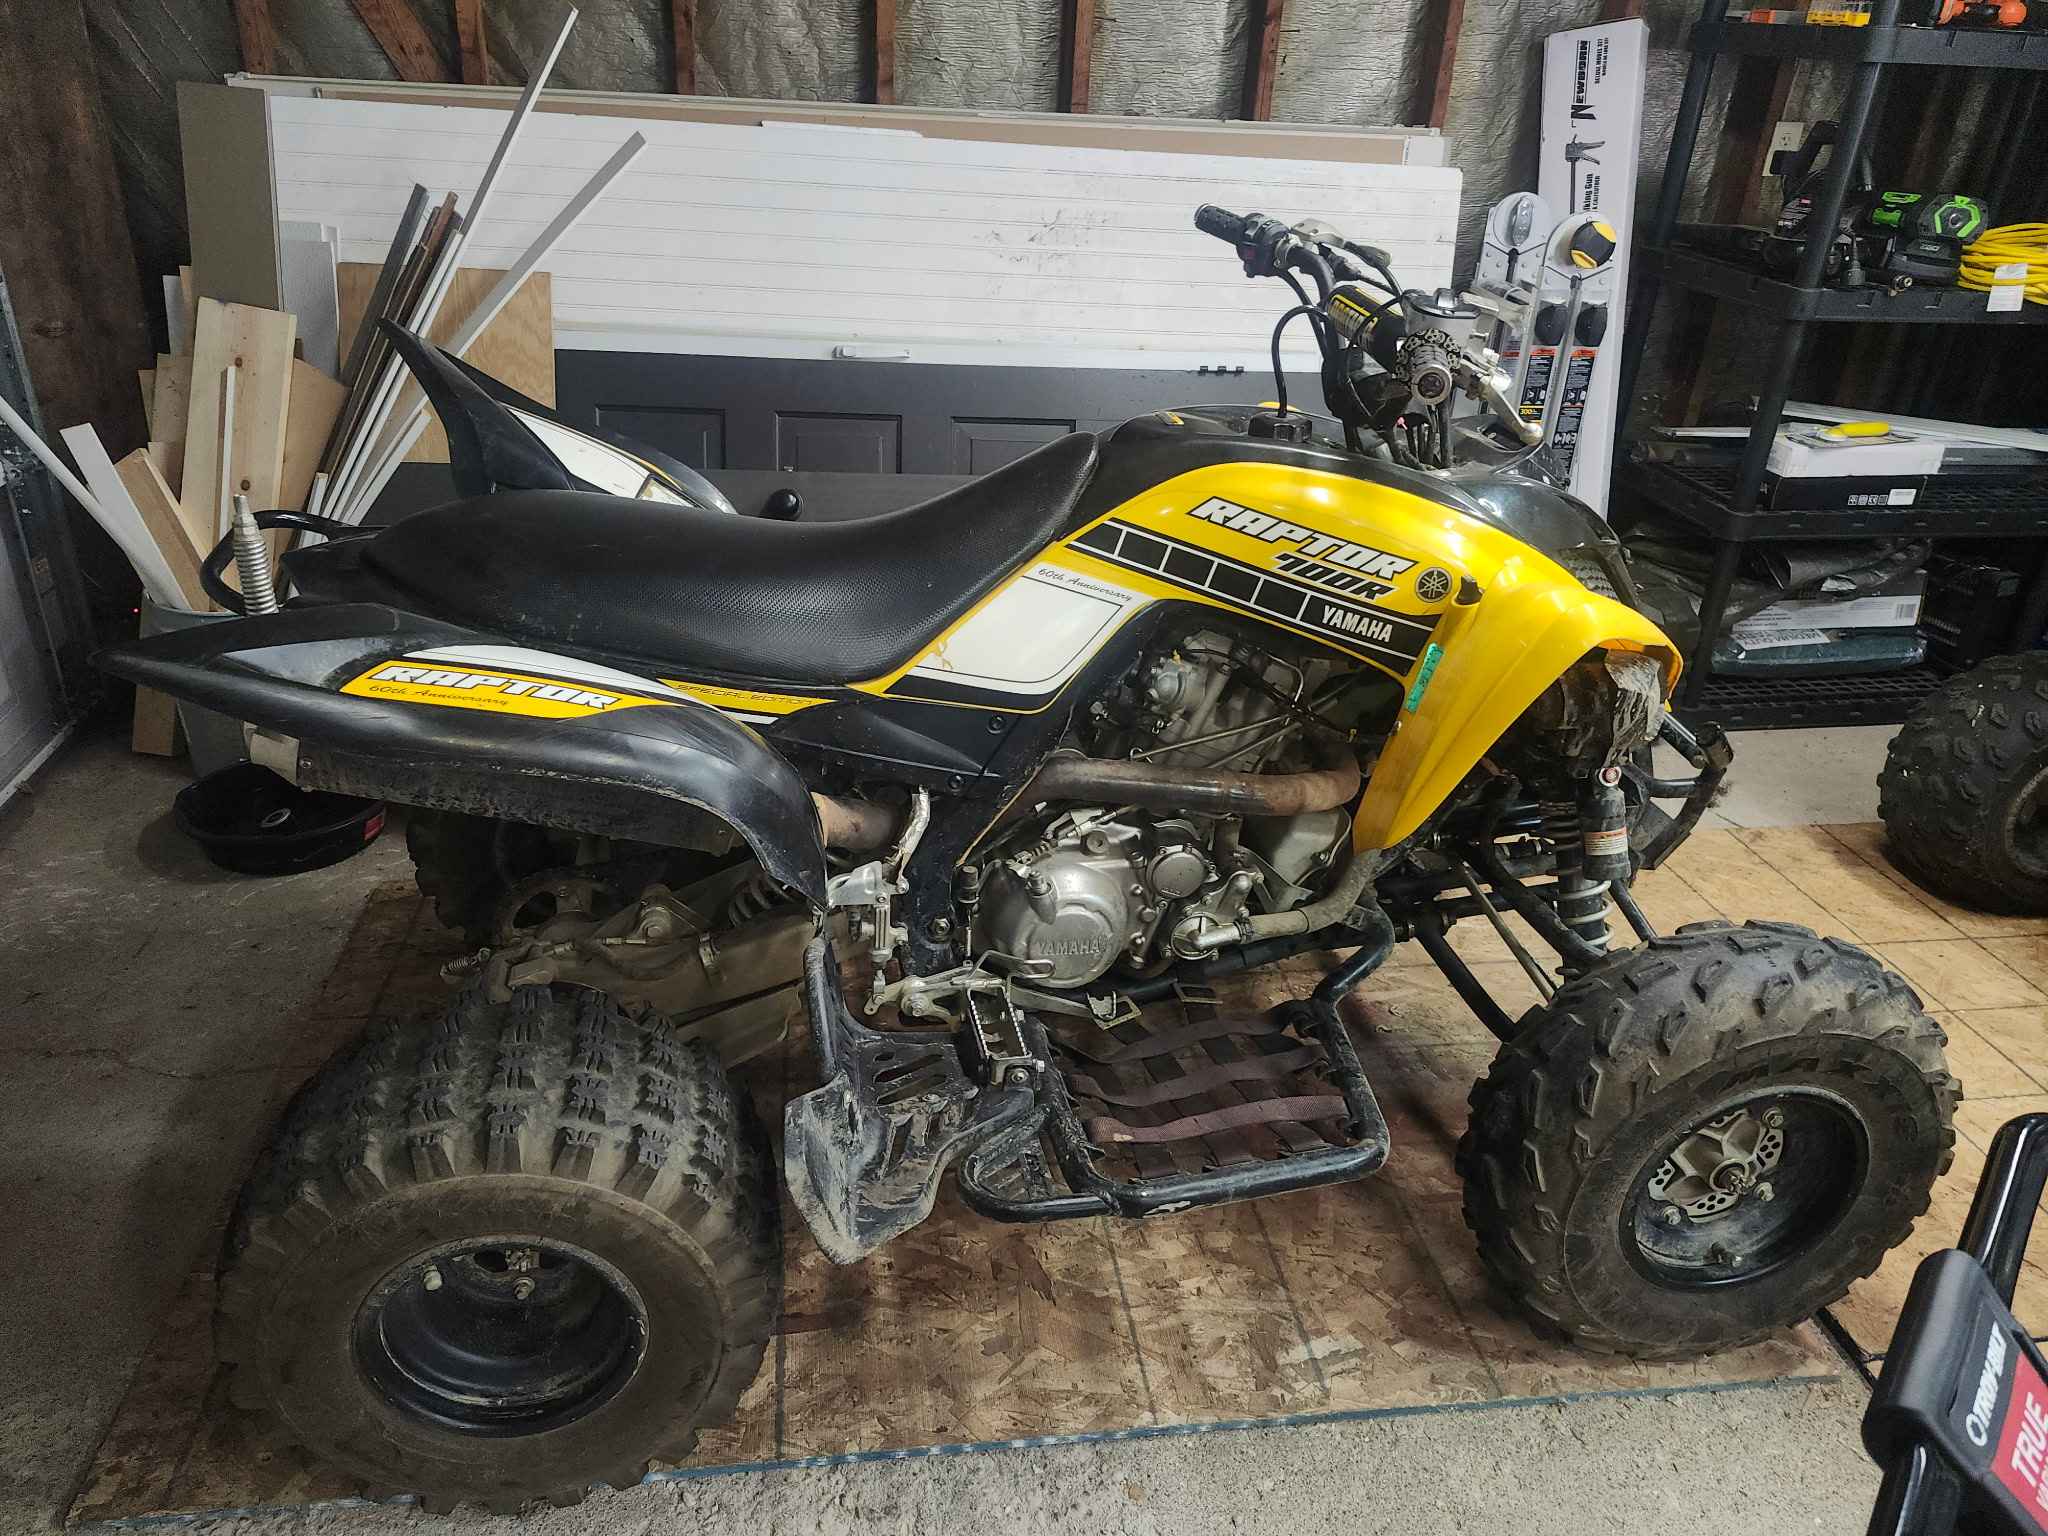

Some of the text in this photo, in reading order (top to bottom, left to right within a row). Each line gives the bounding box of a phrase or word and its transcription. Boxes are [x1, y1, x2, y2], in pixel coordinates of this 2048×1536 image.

[1571, 40, 1596, 120] NEWBORN
[1585, 174, 1593, 190] Gun
[1186, 496, 1419, 581] RAPTOR
[1038, 568, 1132, 602] 60th Anniversary
[1272, 552, 1399, 600] 700R
[1321, 605, 1393, 642] YAMAHA
[368, 666, 621, 710] RAPTOR
[368, 684, 509, 706] 60th Anniversary
[677, 684, 813, 706] SPECIAL EDITION
[1039, 938, 1101, 956] YAMAHA
[2012, 1392, 2048, 1488] TRUE
